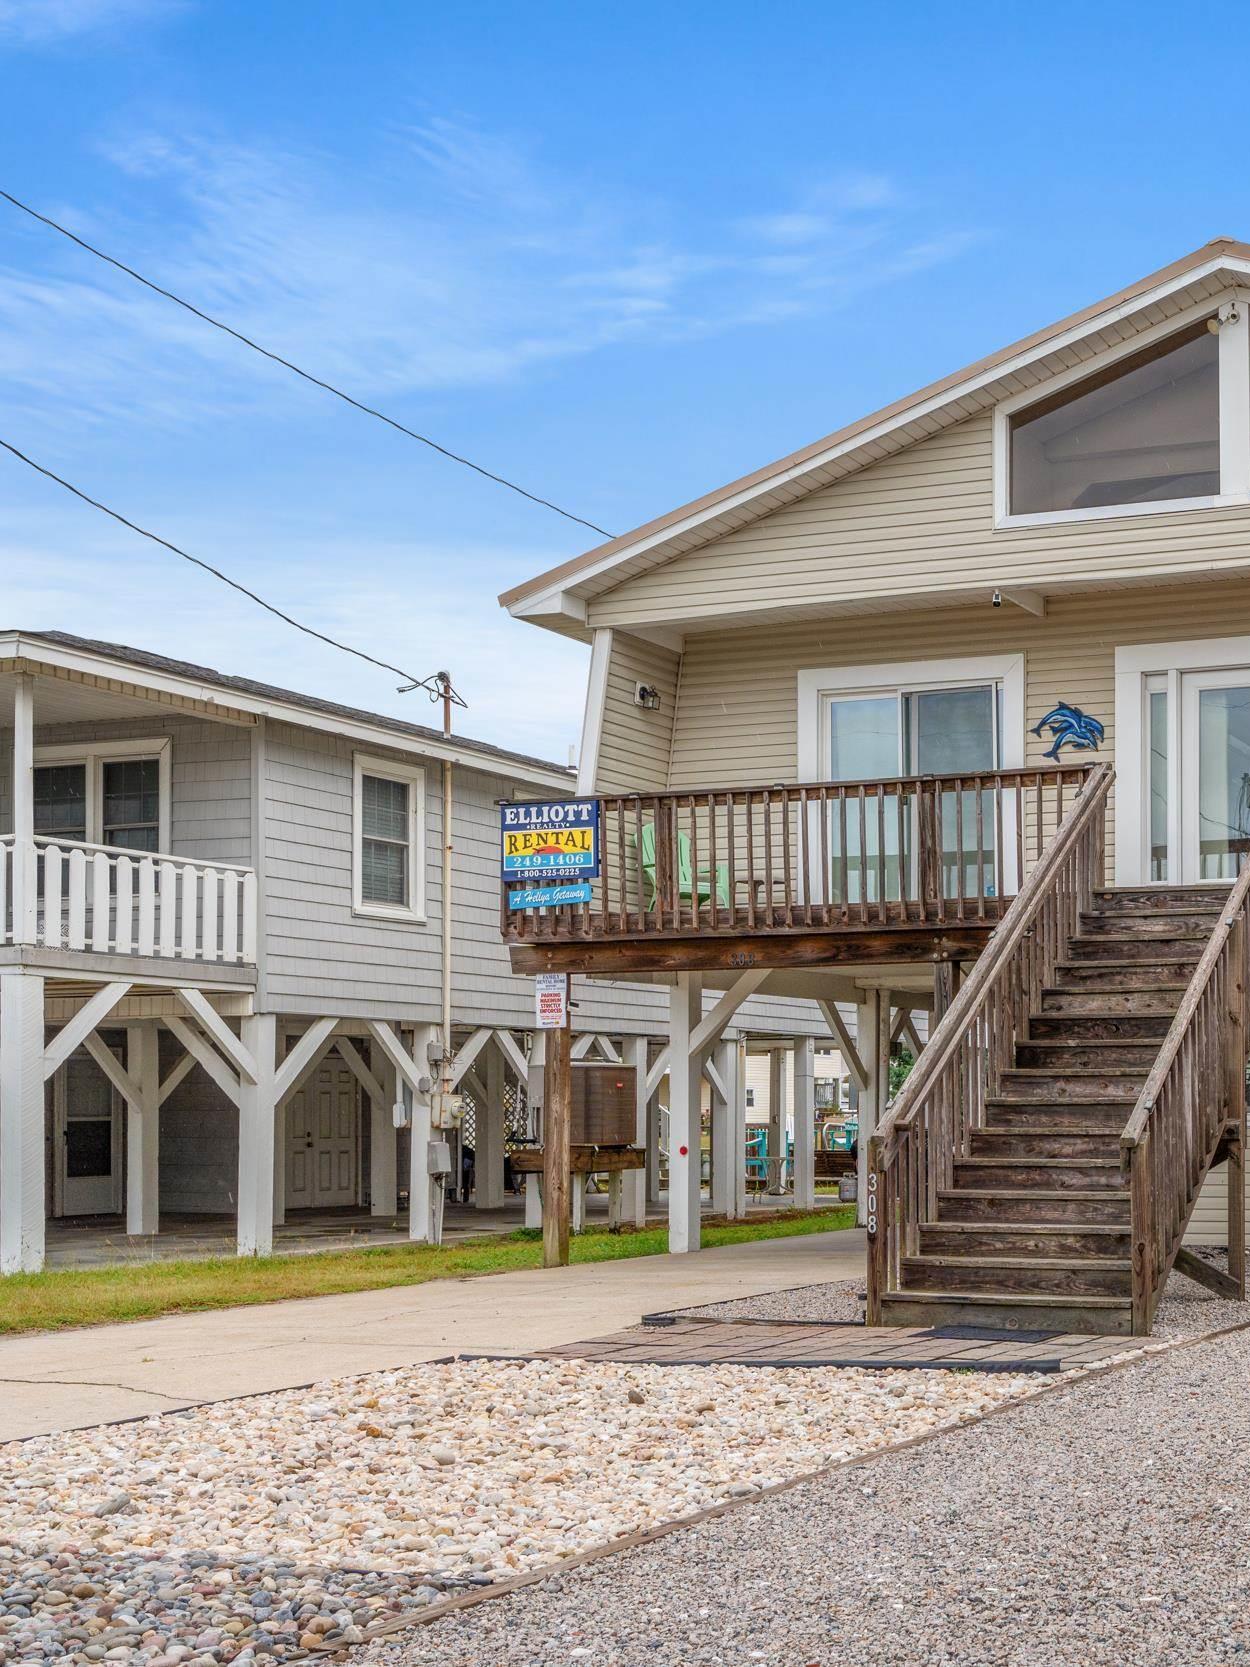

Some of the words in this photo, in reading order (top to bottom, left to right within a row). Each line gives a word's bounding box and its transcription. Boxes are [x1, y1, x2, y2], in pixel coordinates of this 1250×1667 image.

[504, 804, 592, 825] ELLIOTT
[508, 830, 591, 855] RENTAL
[513, 854, 584, 867] 249-1406
[517, 868, 580, 878] 1-800-525-0225
[552, 887, 585, 904] Getaway
[868, 1173, 877, 1233] 308
